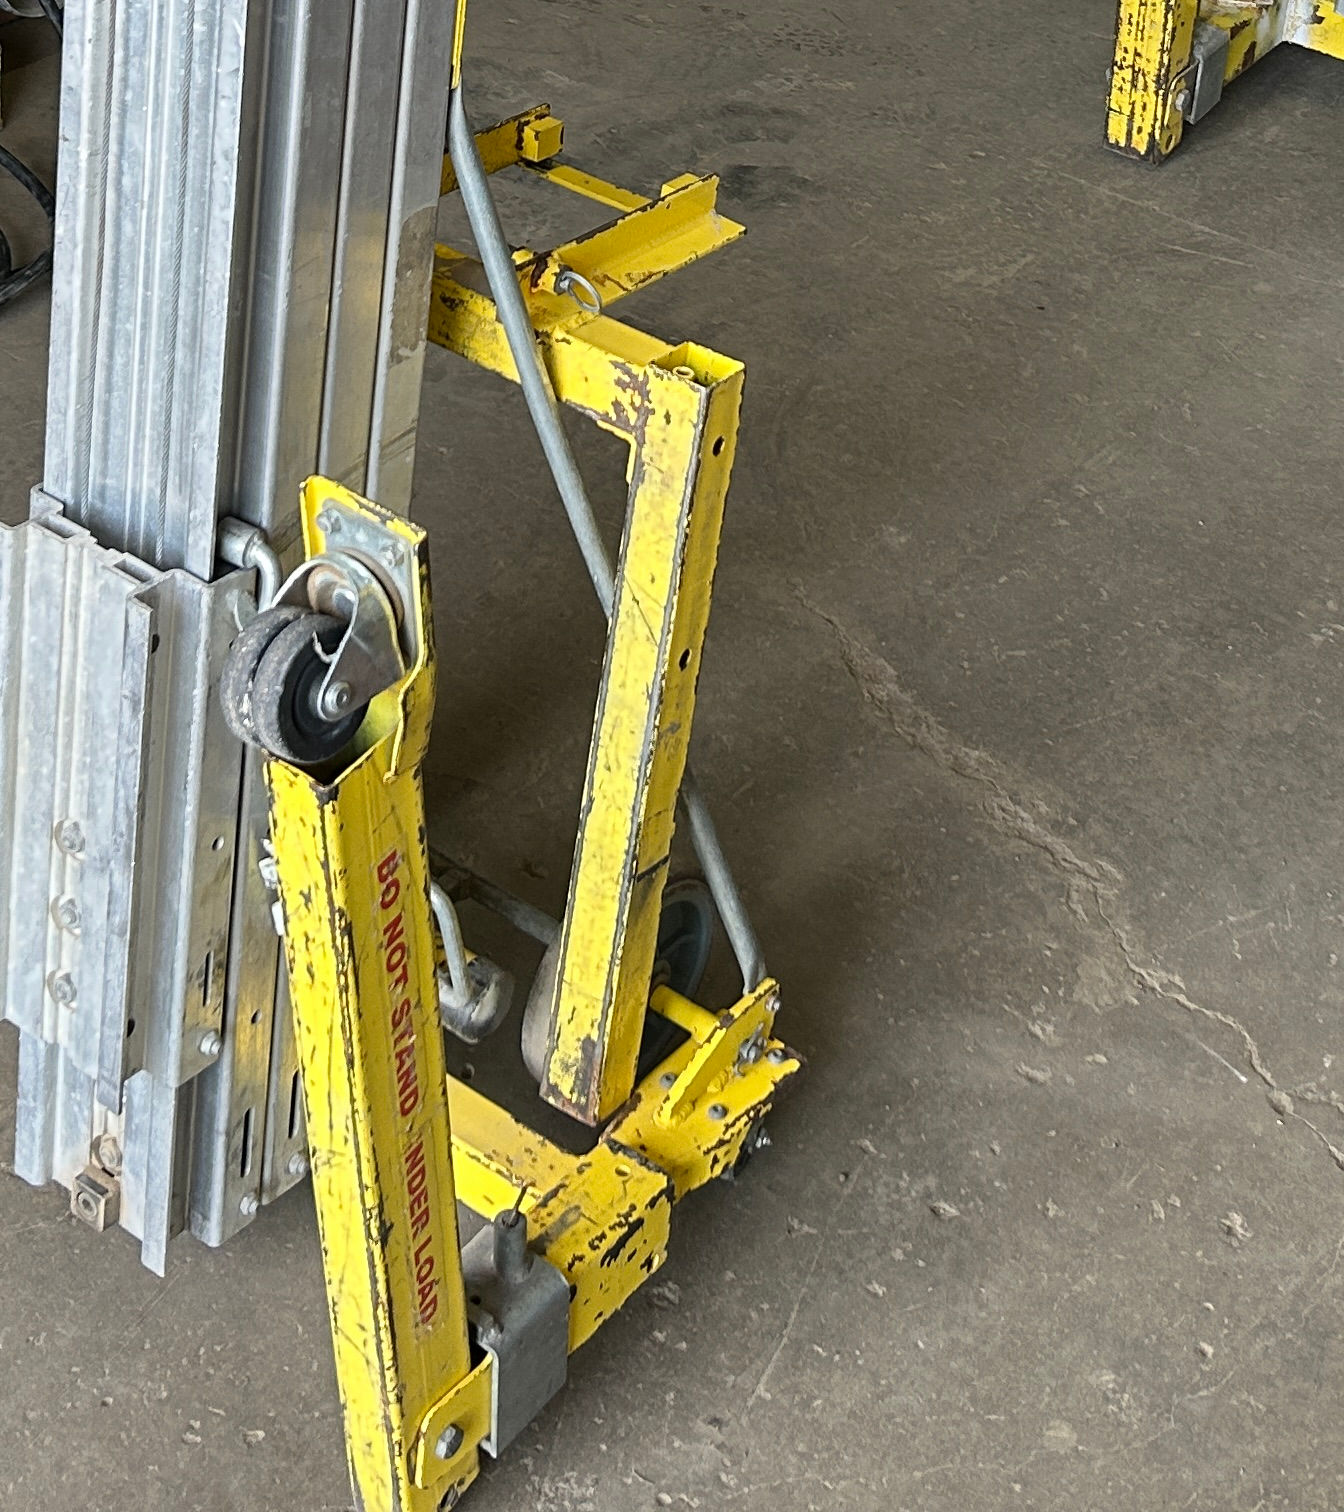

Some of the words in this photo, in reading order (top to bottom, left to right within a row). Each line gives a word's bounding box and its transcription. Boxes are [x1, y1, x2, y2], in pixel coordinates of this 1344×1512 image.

[382, 911, 409, 992] NOT
[391, 997, 419, 1117] STAND
[405, 1126, 431, 1242] NDER
[413, 1234, 439, 1325] LOAD
